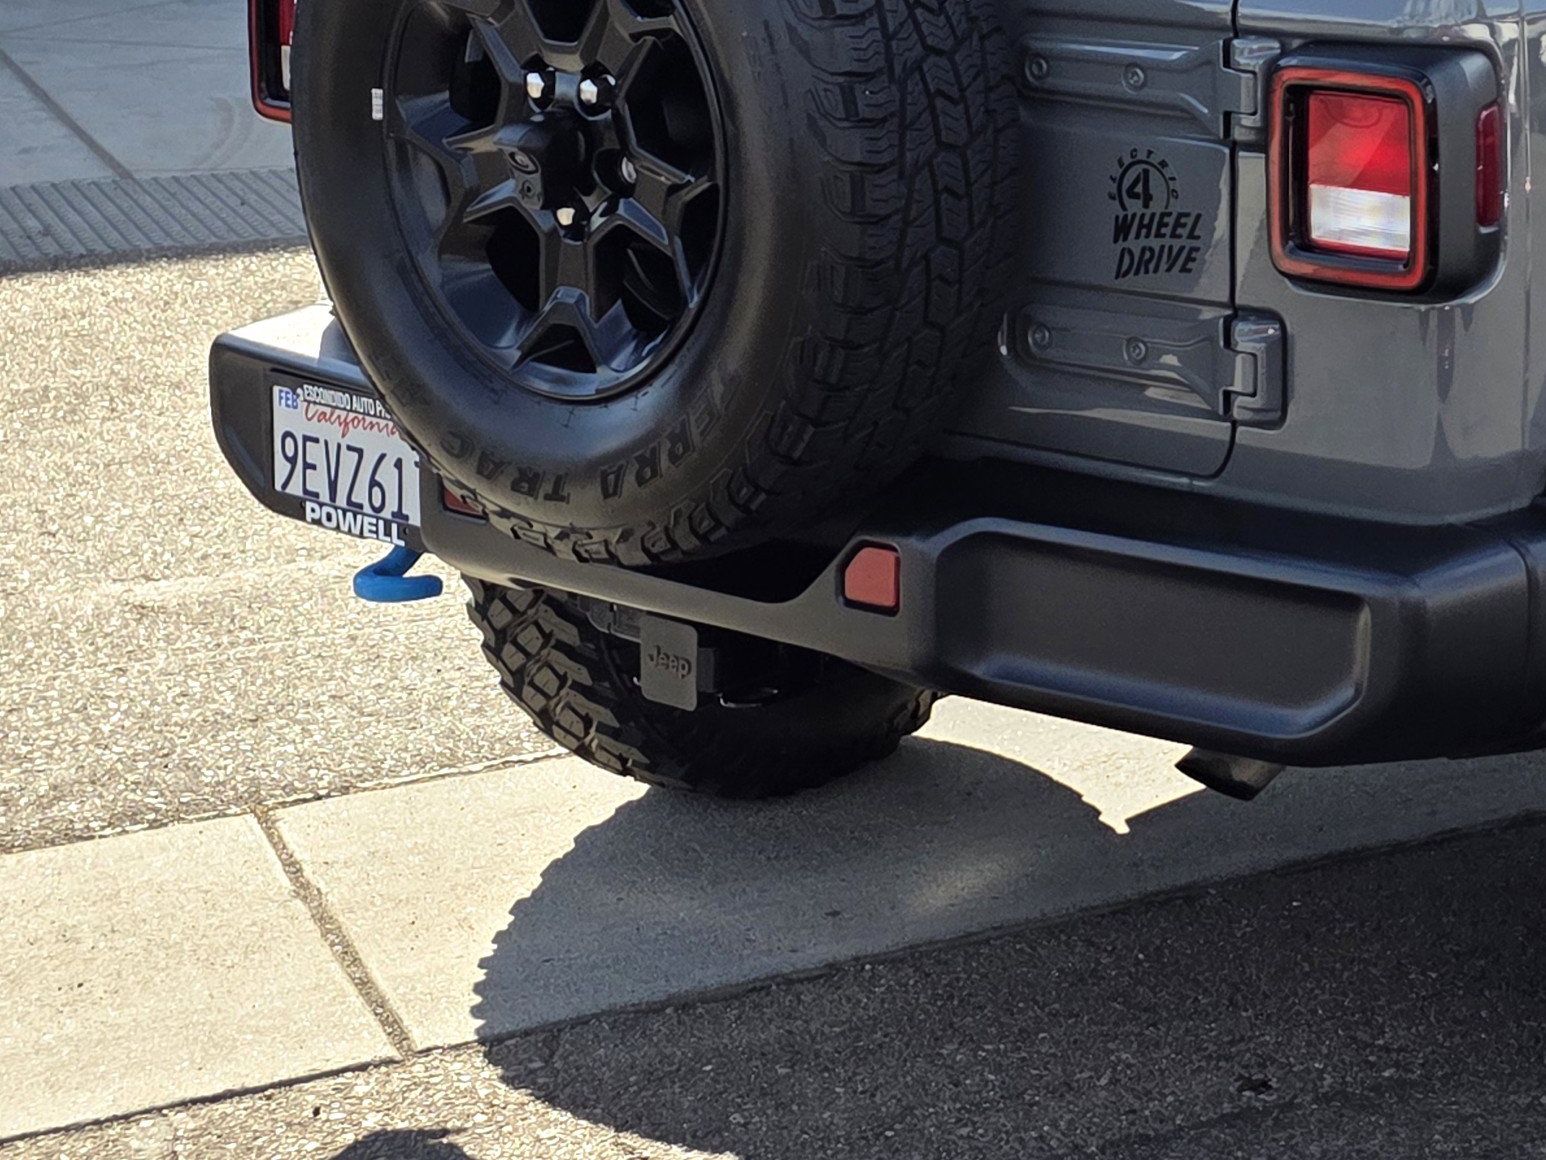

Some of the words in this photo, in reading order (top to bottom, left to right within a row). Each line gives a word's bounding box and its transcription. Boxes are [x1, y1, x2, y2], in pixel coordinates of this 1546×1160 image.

[1126, 168, 1153, 209] 4
[1113, 212, 1202, 244] WHEEL
[1115, 244, 1201, 280] DRIVE
[278, 389, 299, 409] FEB
[303, 384, 351, 410] ESCONDIDO
[352, 395, 375, 415] AUTO
[280, 430, 419, 522] 9EVZ61
[306, 501, 405, 547] POWELL
[648, 644, 693, 679] Jeep
